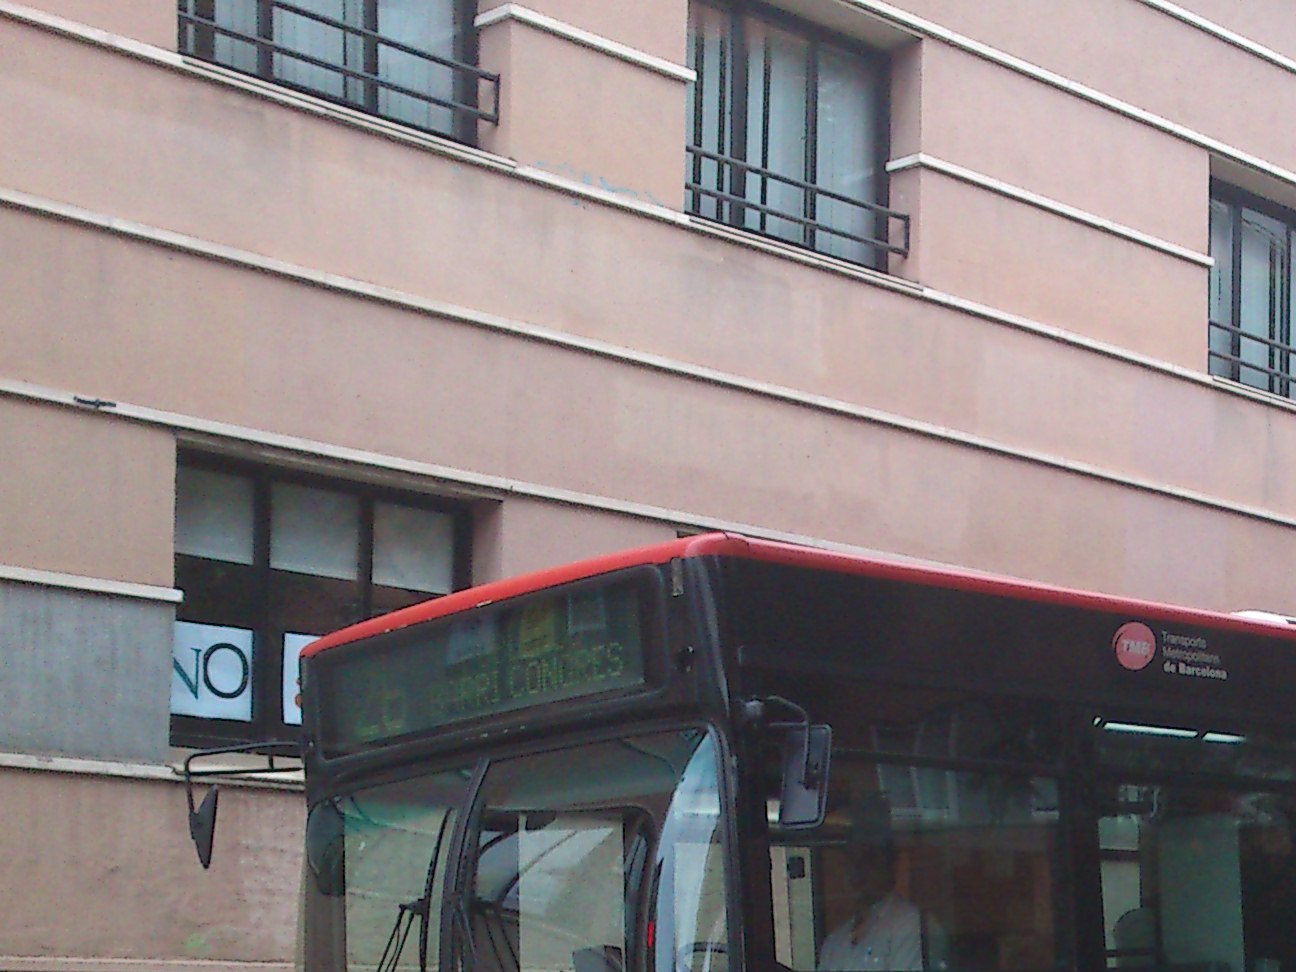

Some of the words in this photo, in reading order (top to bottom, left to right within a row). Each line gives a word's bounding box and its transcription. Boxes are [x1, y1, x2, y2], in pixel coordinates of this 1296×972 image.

[1122, 639, 1151, 656] TMB
[1163, 660, 1177, 673] de
[1178, 662, 1228, 680] Barcelona
